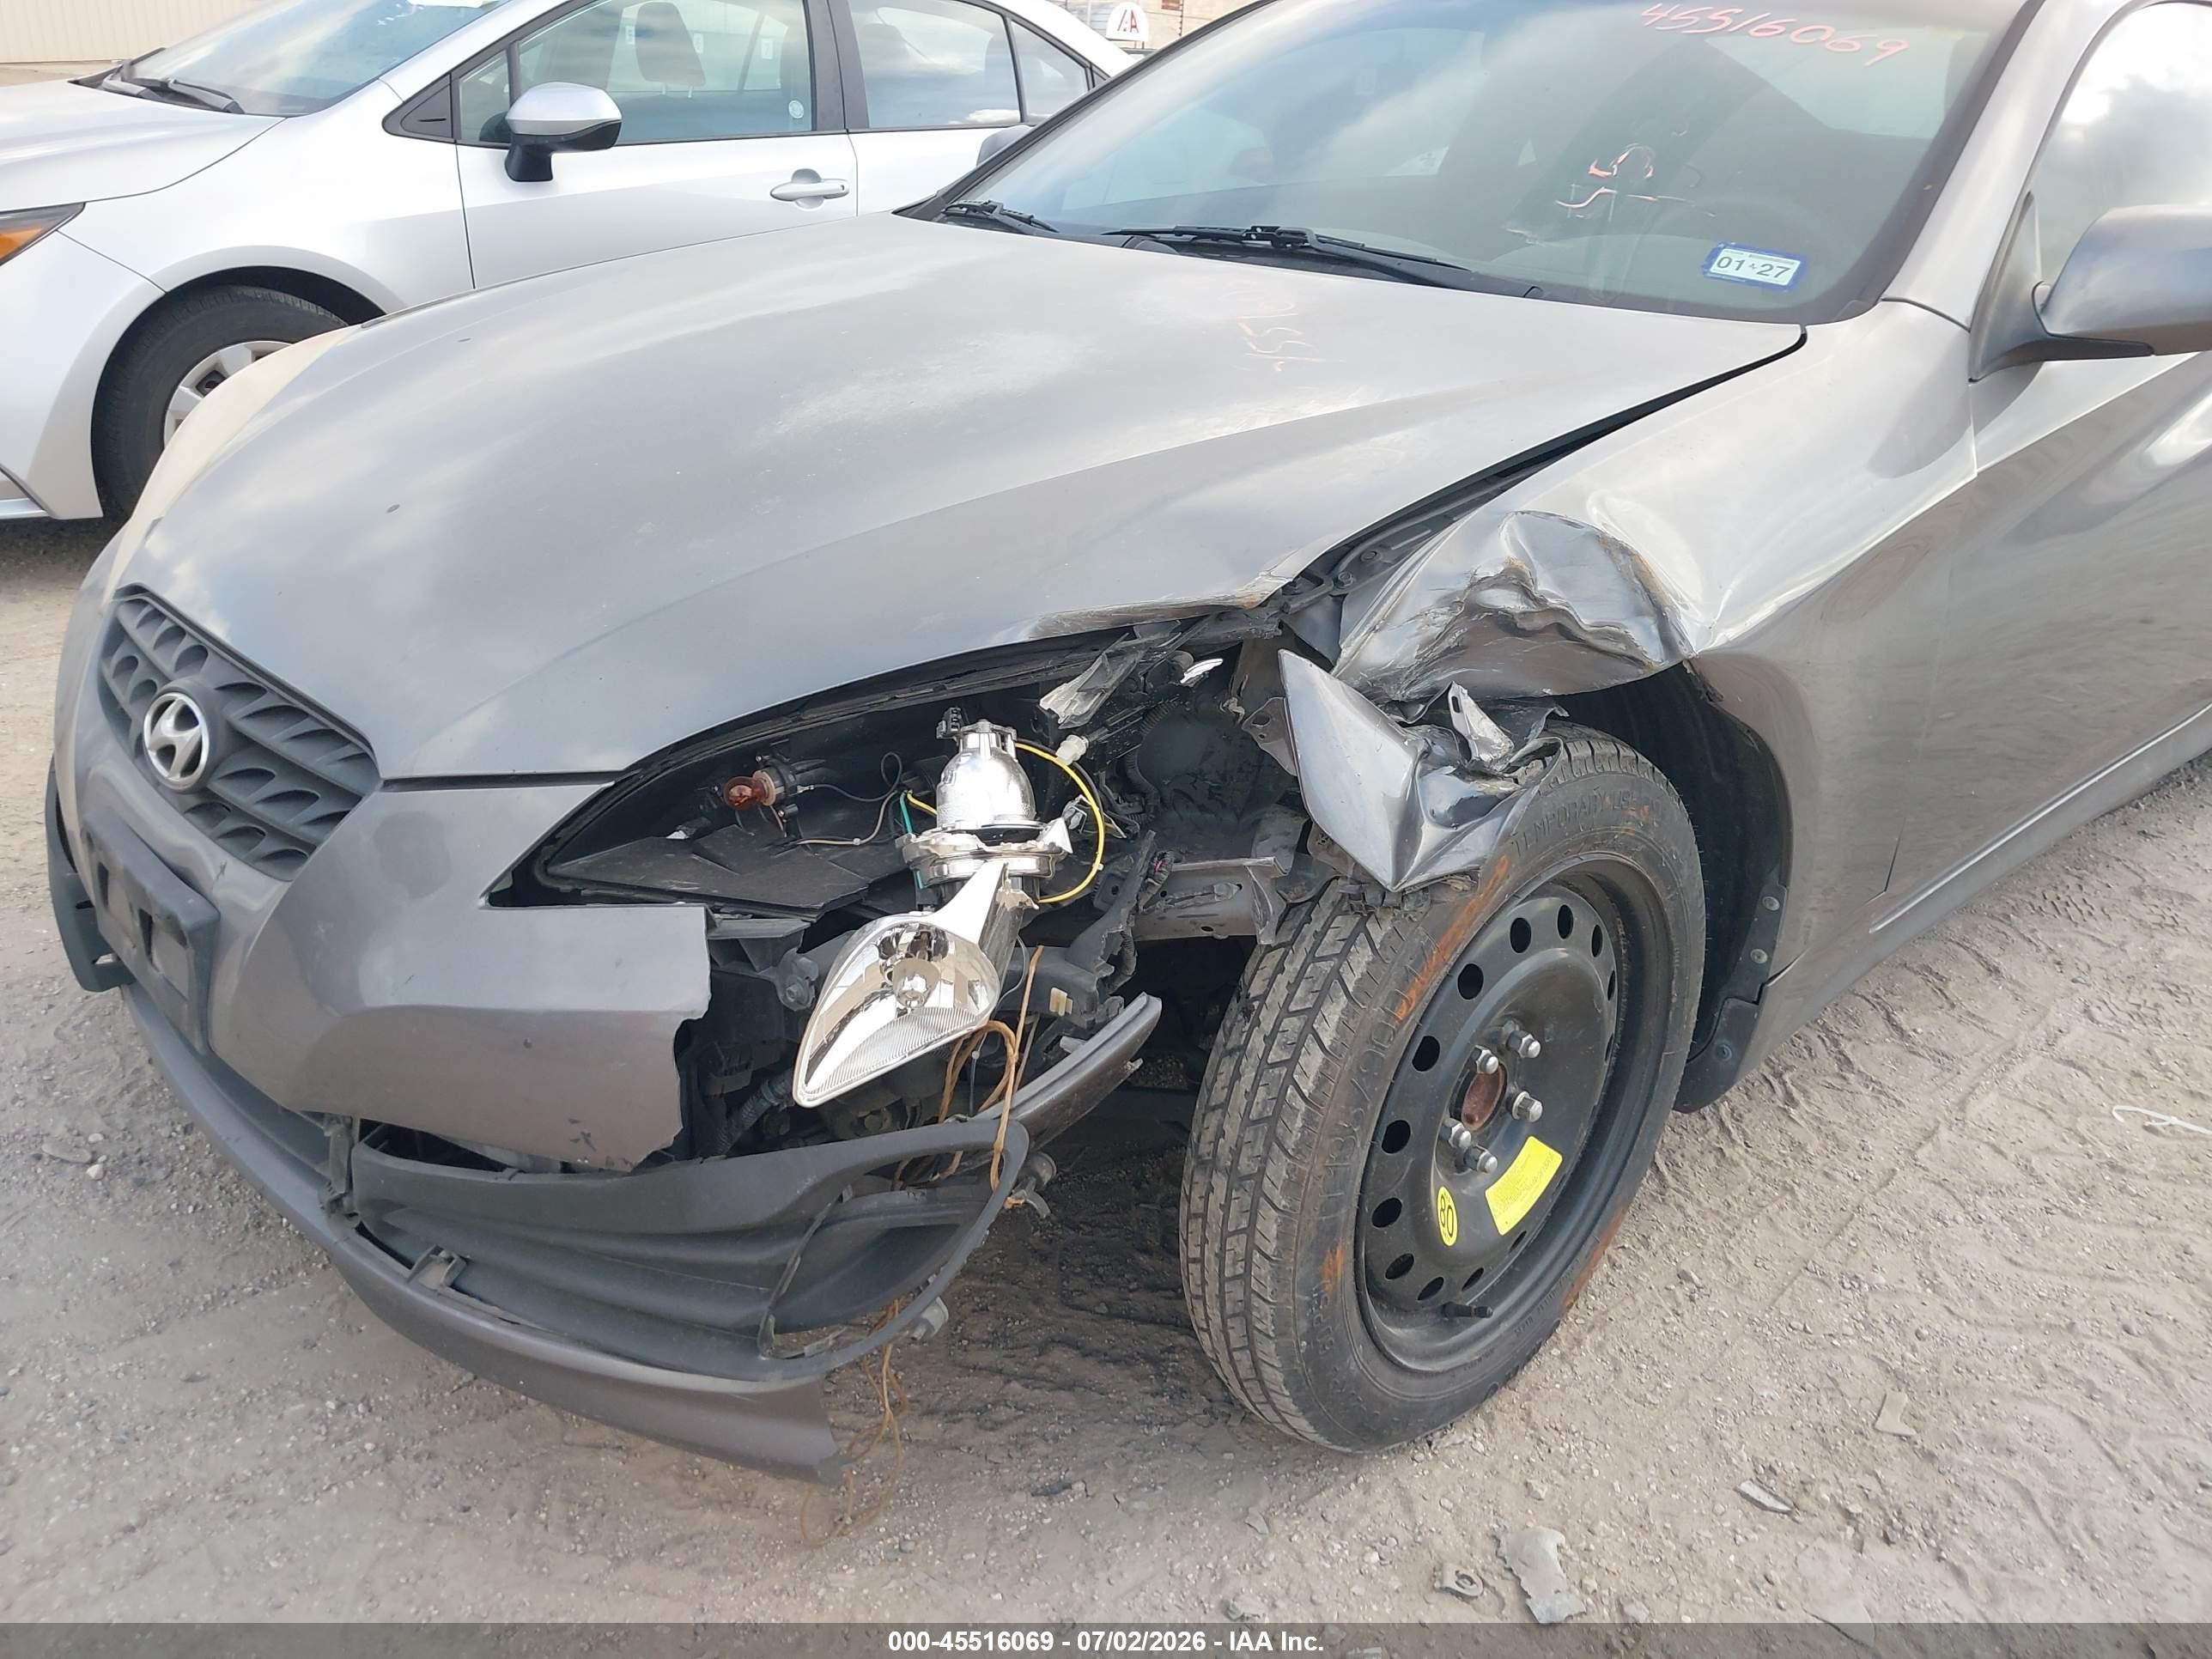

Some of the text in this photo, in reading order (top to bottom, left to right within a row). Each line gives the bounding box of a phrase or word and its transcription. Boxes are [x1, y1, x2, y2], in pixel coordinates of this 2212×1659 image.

[1641, 3, 1909, 67] 45516069
[1717, 256, 1746, 271] 01
[1756, 263, 1791, 278] 27
